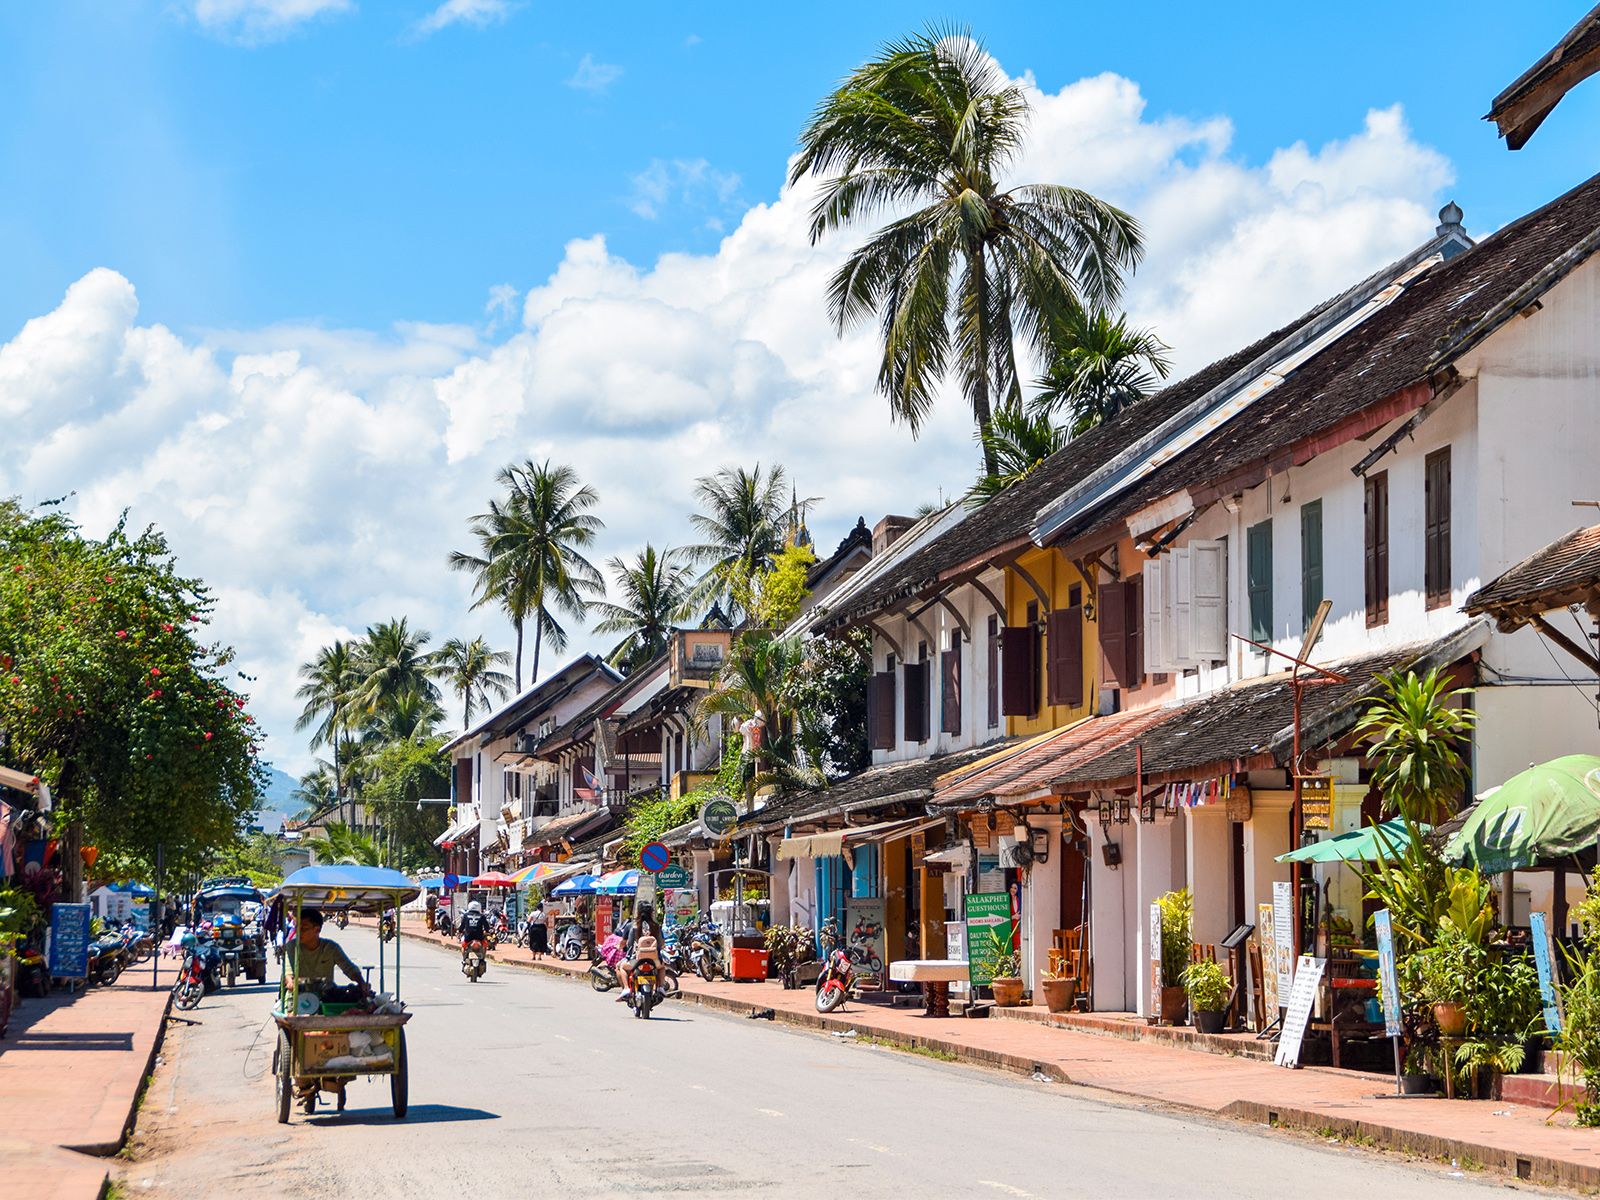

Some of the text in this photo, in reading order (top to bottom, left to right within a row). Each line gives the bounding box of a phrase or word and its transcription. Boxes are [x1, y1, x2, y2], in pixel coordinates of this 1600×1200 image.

[658, 870, 683, 878] Garden
[967, 895, 1007, 904] SALAKPHET
[967, 904, 1008, 912] GUESTHOUSE
